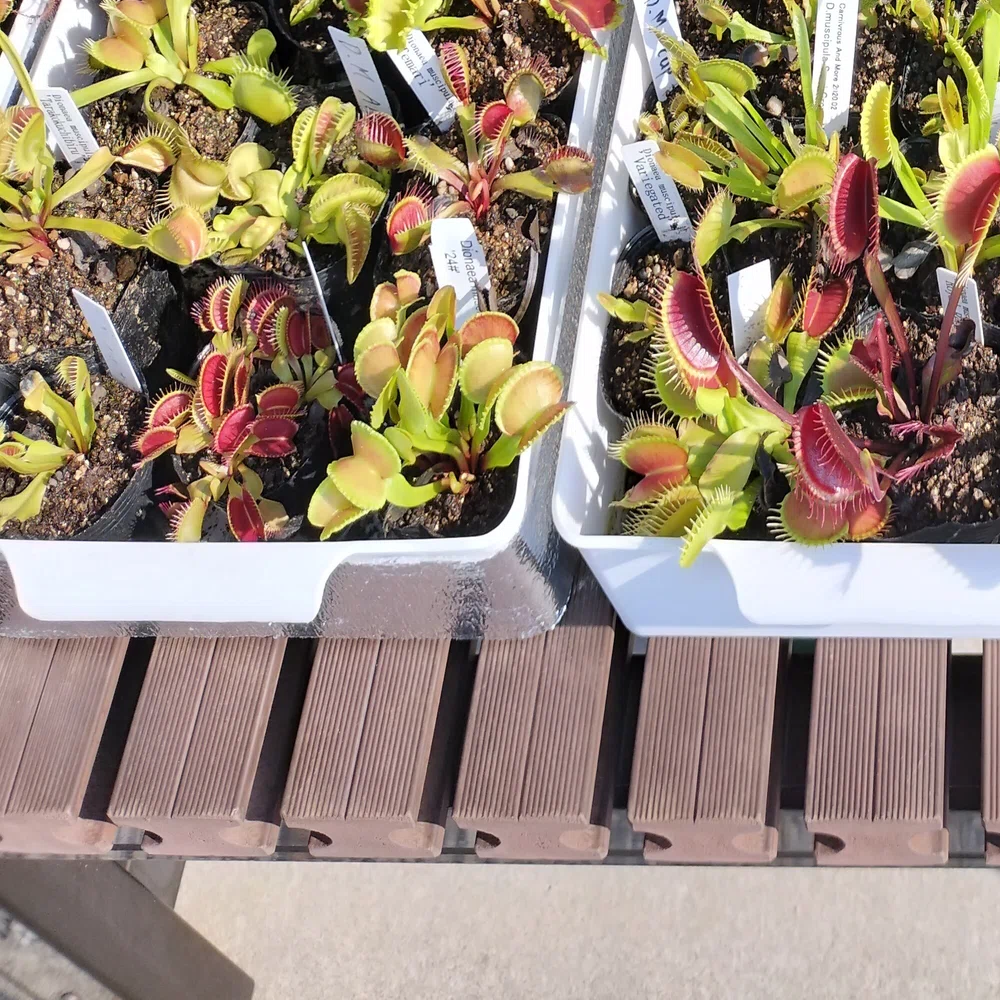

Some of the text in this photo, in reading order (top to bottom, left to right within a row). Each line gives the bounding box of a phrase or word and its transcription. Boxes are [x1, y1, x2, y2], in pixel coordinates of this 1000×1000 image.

[52, 93, 73, 122] Dionaea
[642, 147, 662, 181] Dionaea
[460, 239, 479, 284] Dionaea
